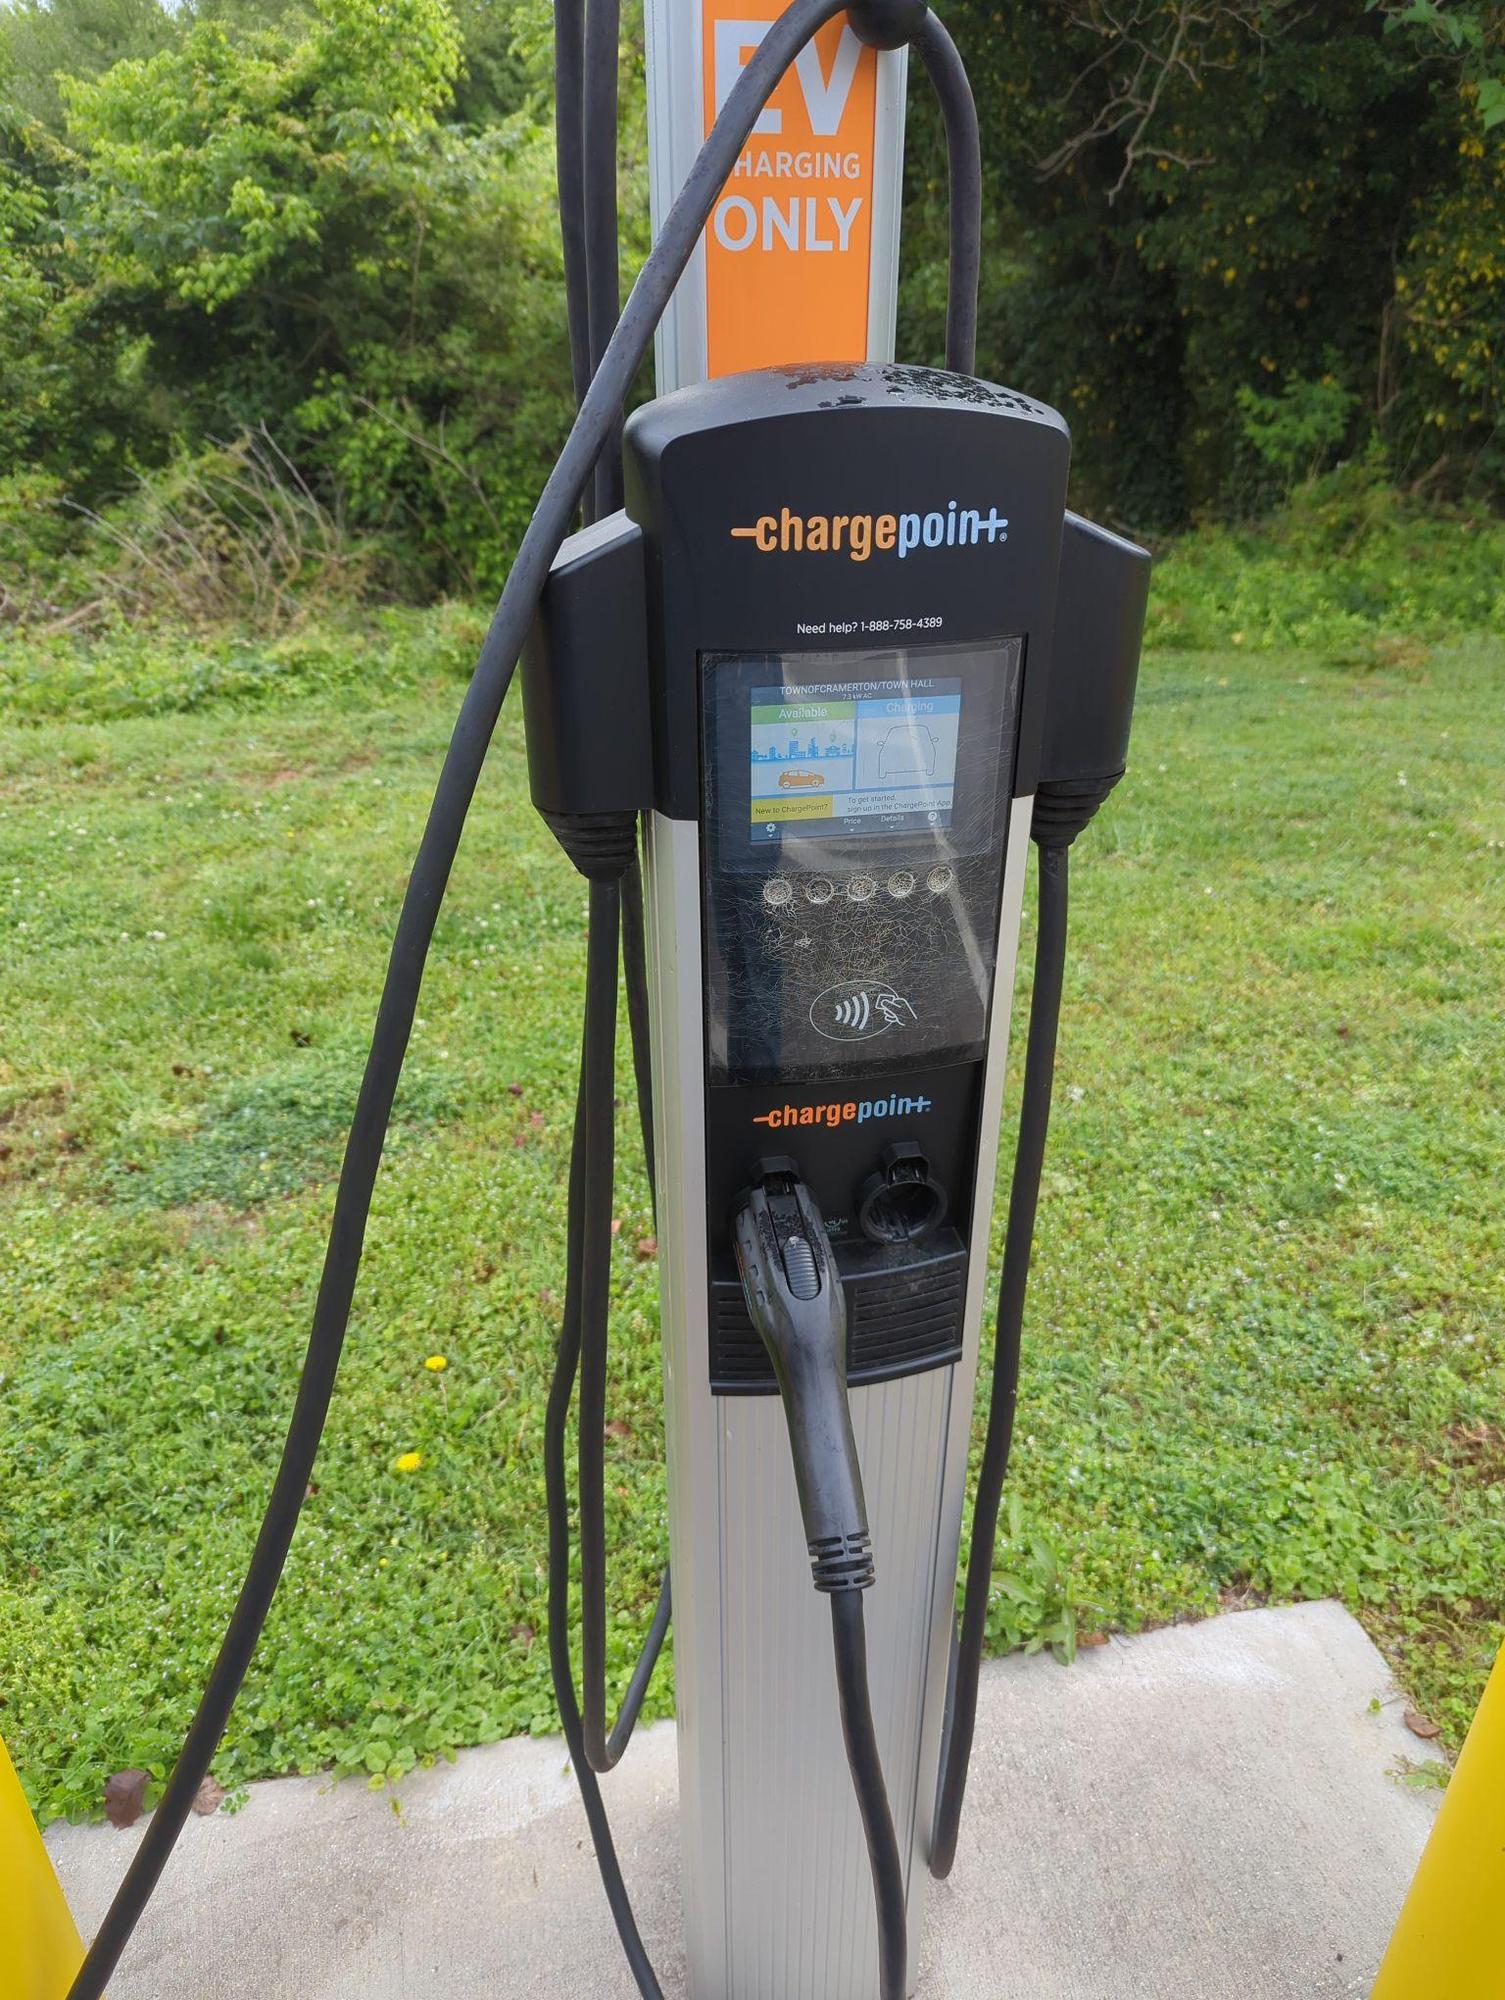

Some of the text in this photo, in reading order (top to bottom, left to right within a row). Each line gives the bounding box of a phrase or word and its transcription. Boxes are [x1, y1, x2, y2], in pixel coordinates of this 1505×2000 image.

[714, 20, 866, 136] EV
[731, 151, 861, 179] HARGING
[714, 195, 863, 252] ONLY
[797, 616, 943, 634] Need help? 1-888-758-4389
[910, 679, 935, 689] HALL
[779, 707, 828, 719] Available
[886, 702, 934, 713] Charging
[857, 797, 869, 805] get
[894, 801, 936, 811] ChargePoint
[781, 803, 828, 814] ChargePoint?
[880, 815, 904, 823] Details
